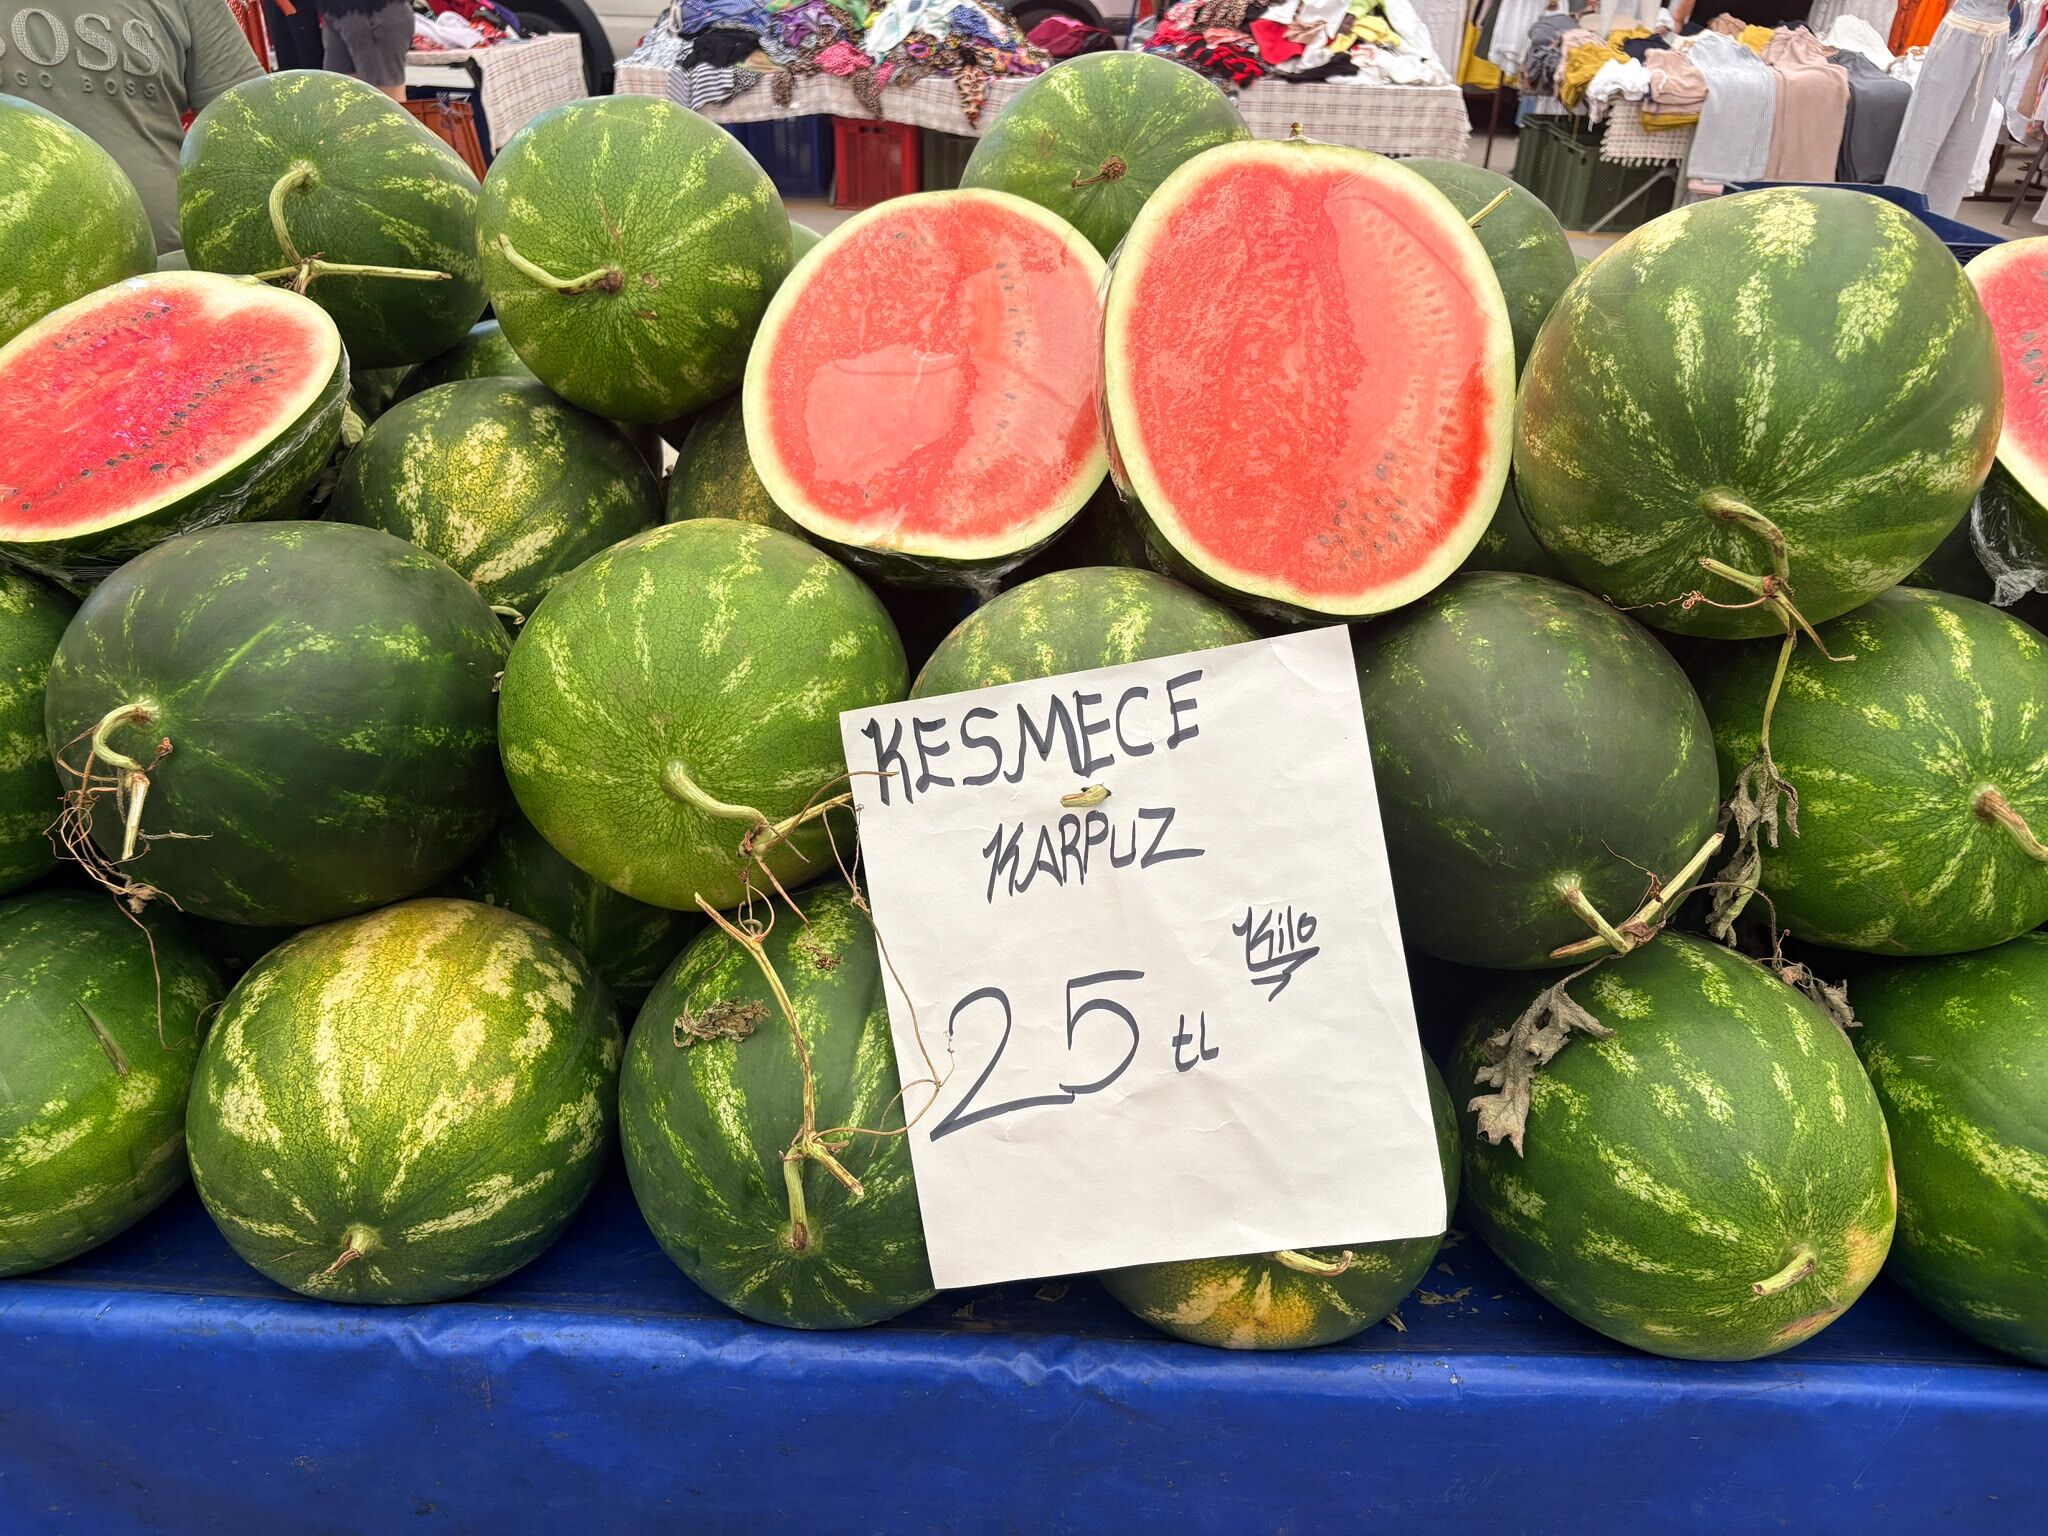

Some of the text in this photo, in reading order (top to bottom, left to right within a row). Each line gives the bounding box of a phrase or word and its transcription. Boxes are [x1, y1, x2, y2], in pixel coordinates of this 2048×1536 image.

[0, 8, 160, 77] OSS
[81, 75, 156, 99] BOSS
[861, 669, 1203, 806] KESMECE
[983, 807, 1206, 904] KARPUZ
[1232, 905, 1319, 970] Kilo
[930, 970, 1145, 1142] 25
